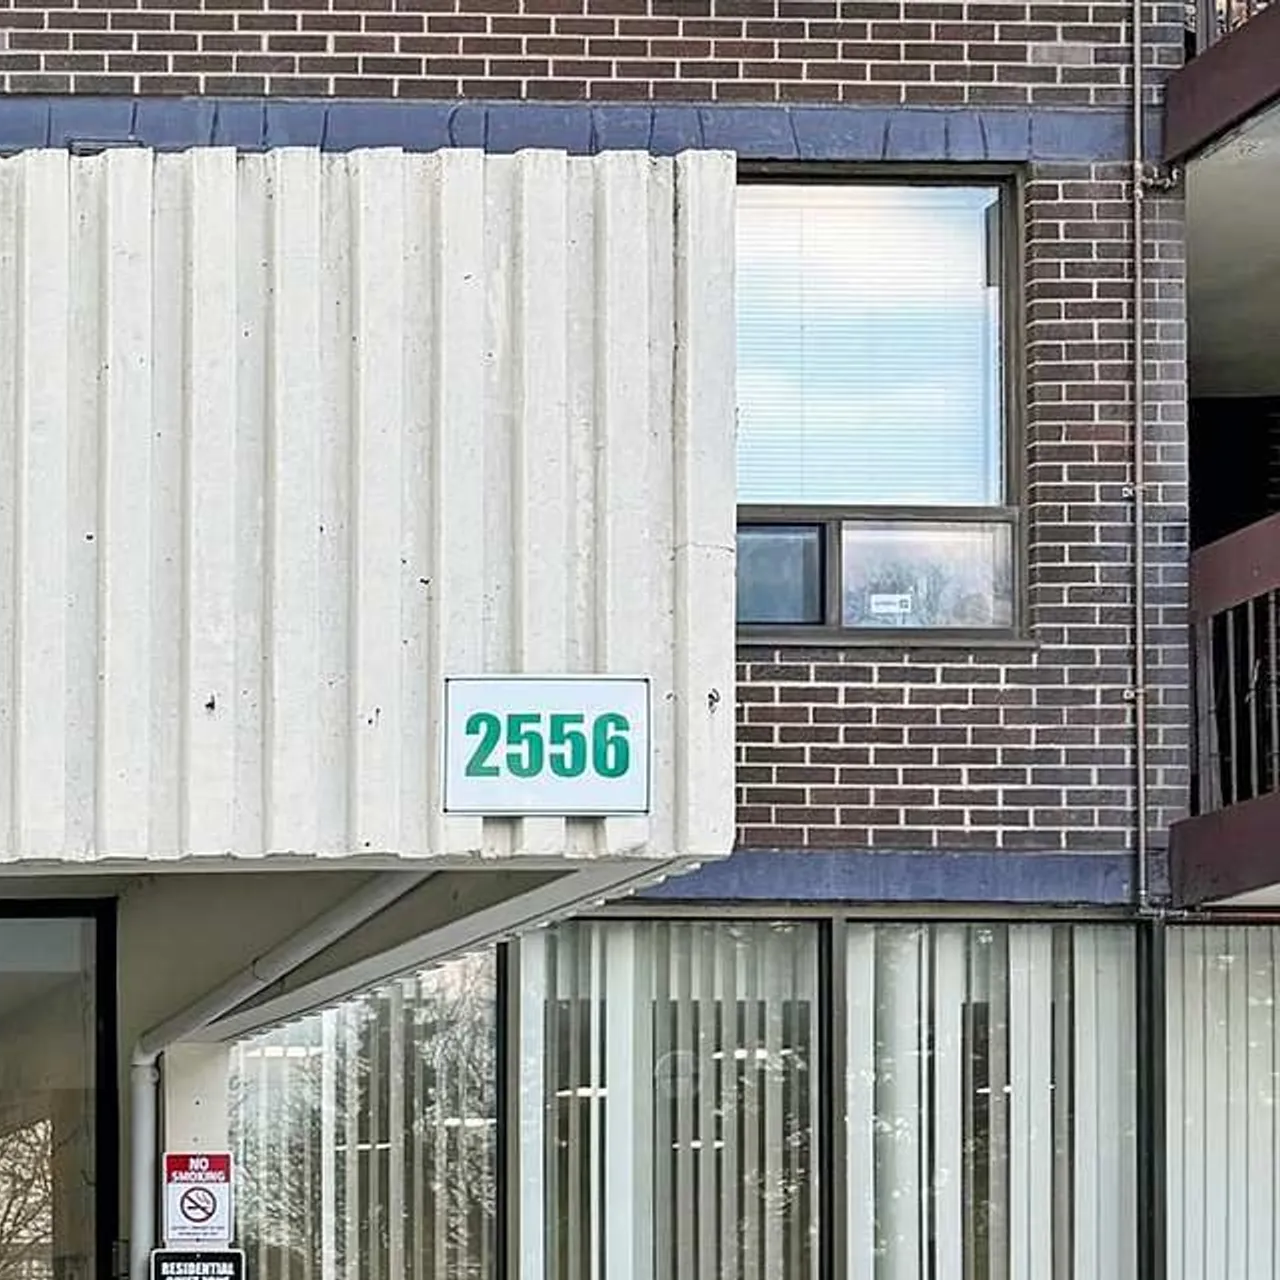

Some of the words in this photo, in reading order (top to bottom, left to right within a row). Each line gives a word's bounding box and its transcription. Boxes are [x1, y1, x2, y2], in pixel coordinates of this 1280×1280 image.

[464, 712, 630, 778] 2556
[189, 1158, 209, 1171] NO
[172, 1171, 226, 1183] SMOKING
[161, 1261, 235, 1275] RESIDENTIAL
